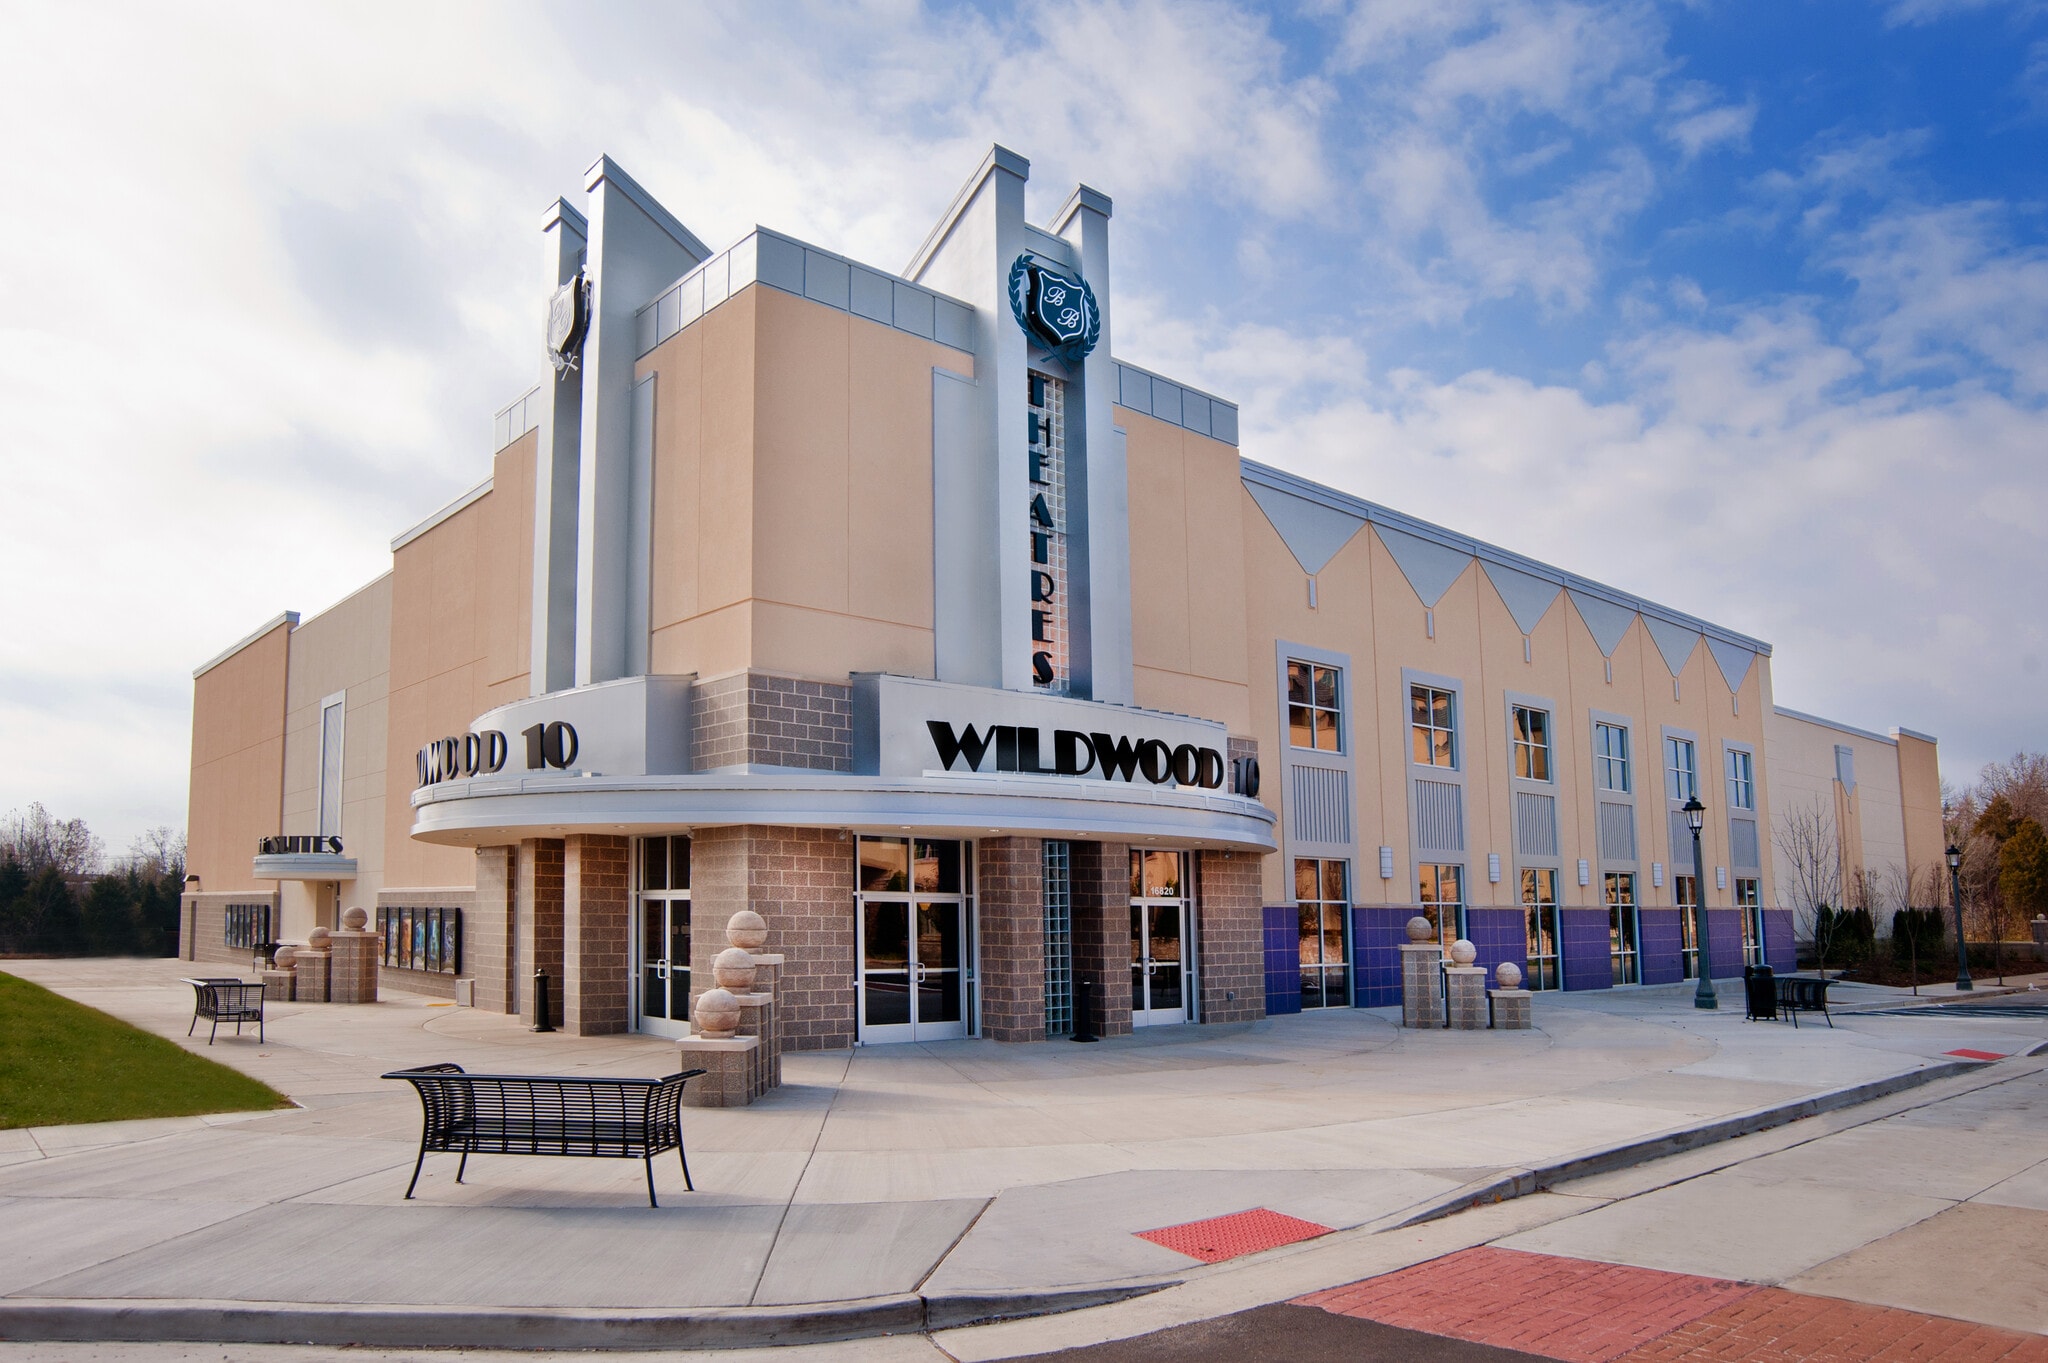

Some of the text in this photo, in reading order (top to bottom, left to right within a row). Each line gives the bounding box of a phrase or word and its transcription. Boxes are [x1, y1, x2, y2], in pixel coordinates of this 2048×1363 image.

[1044, 286, 1067, 307] B
[1057, 307, 1080, 328] B
[1028, 374, 1055, 684] THEATRES
[521, 720, 579, 770] 10
[926, 720, 1260, 797] WILDWOOD 10
[1151, 886, 1174, 896] 16820
